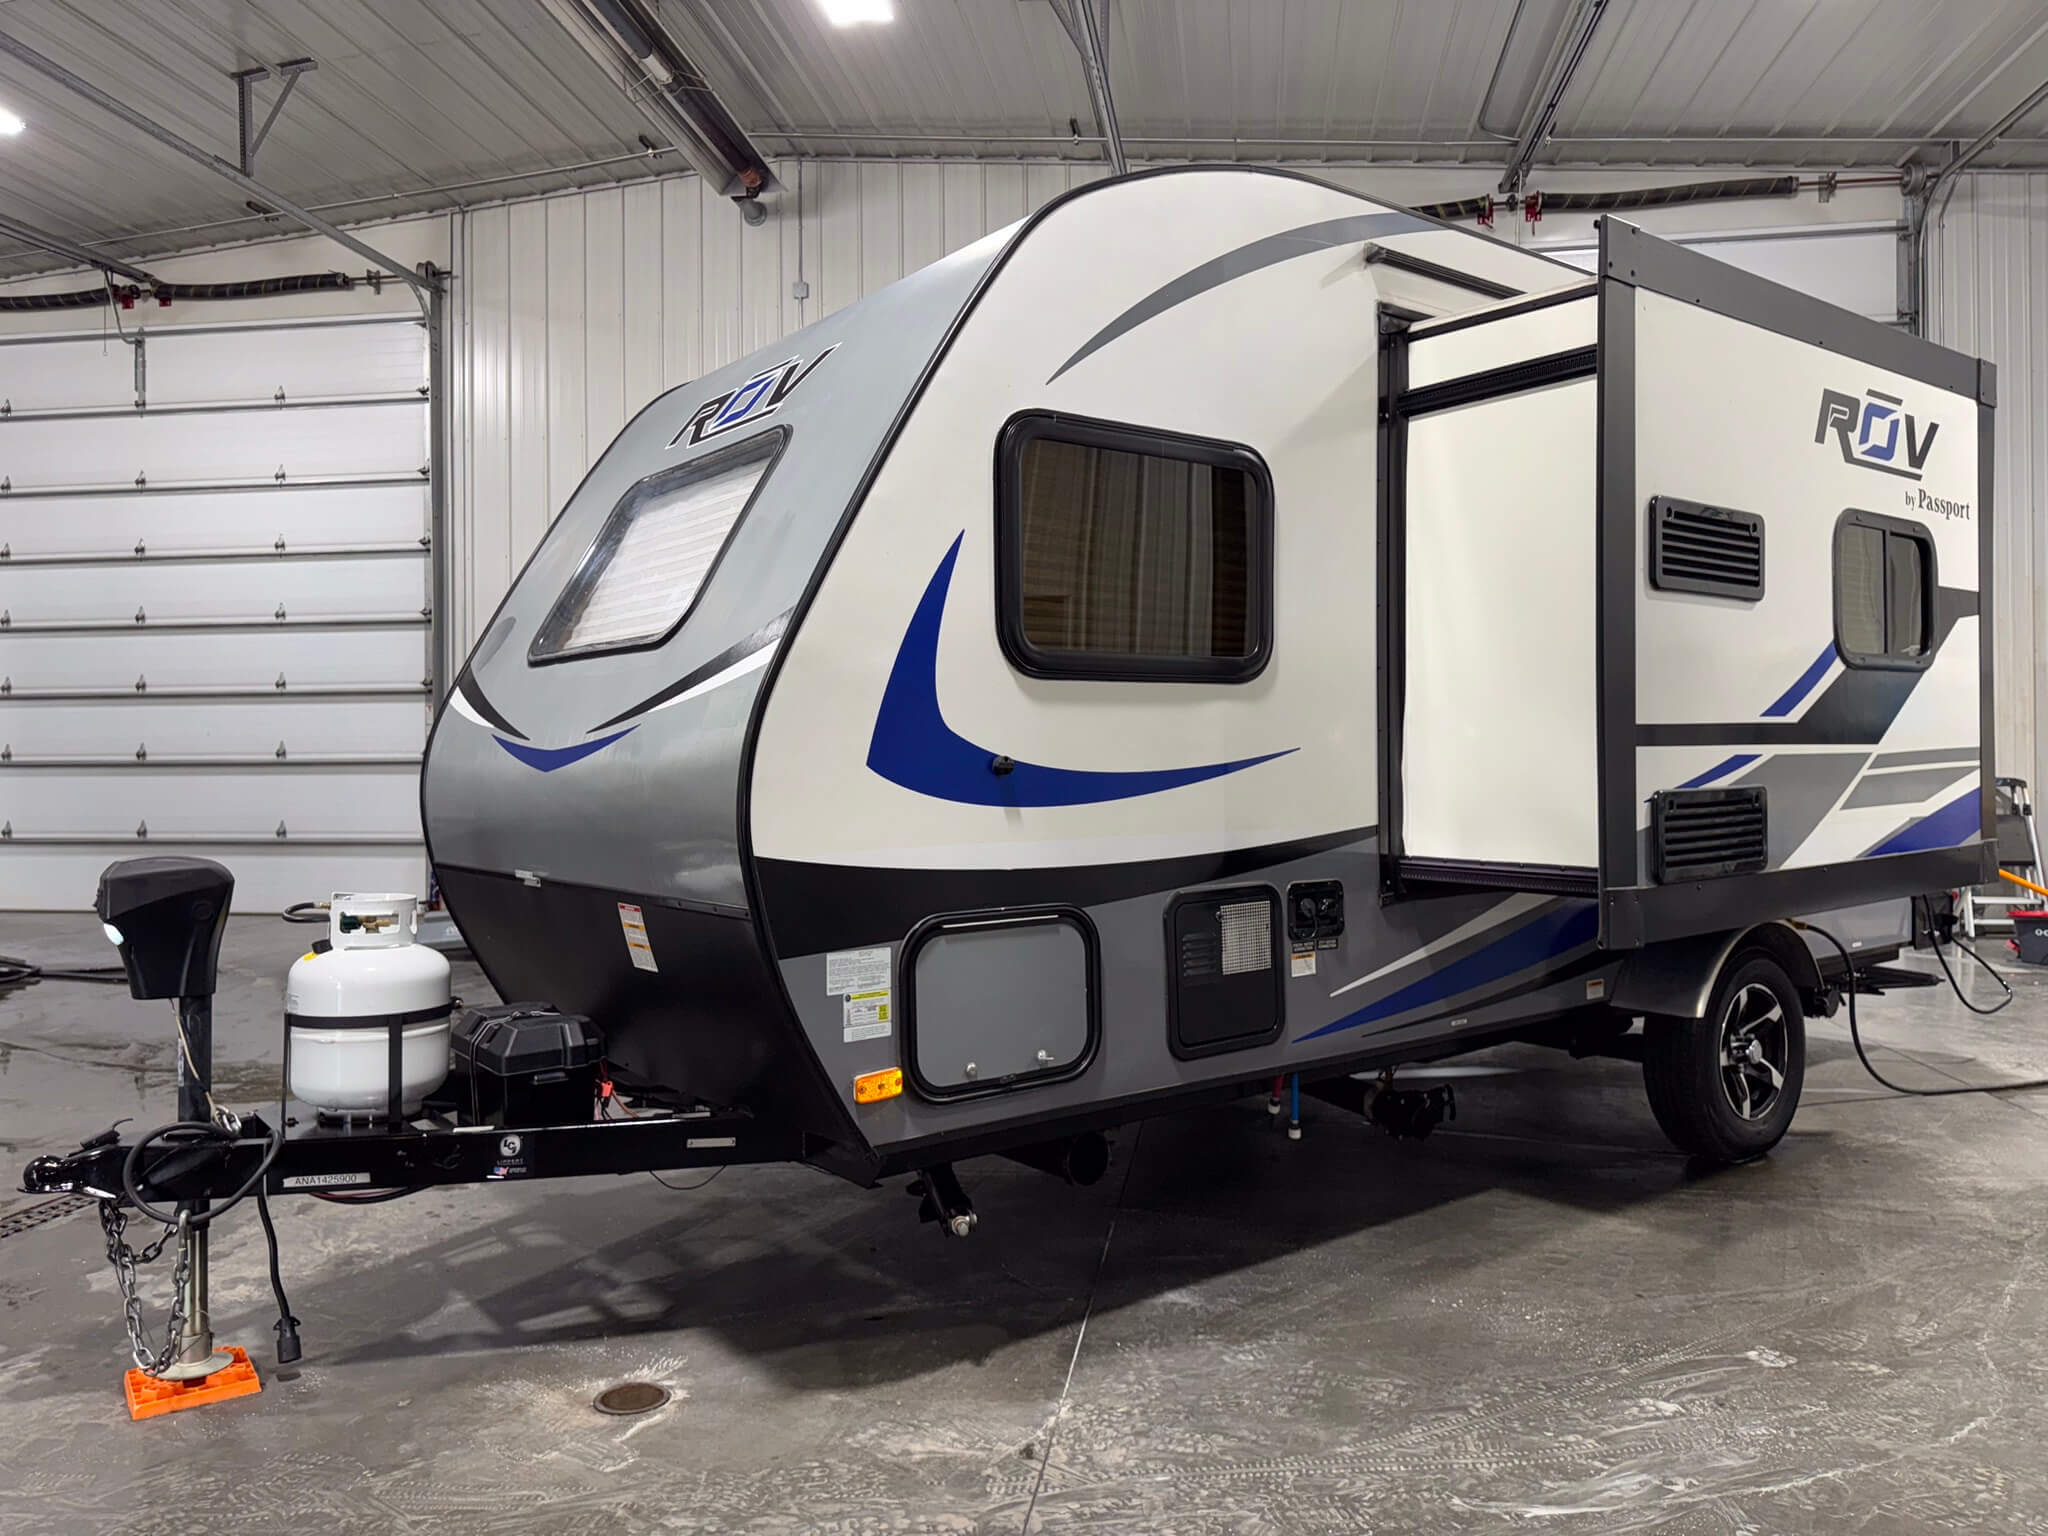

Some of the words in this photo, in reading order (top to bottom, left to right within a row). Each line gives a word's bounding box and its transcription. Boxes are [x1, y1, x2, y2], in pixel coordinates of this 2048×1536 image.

[1905, 491, 1917, 512] by
[1918, 488, 1970, 520] Passport
[295, 1174, 357, 1186] ANA1425900
